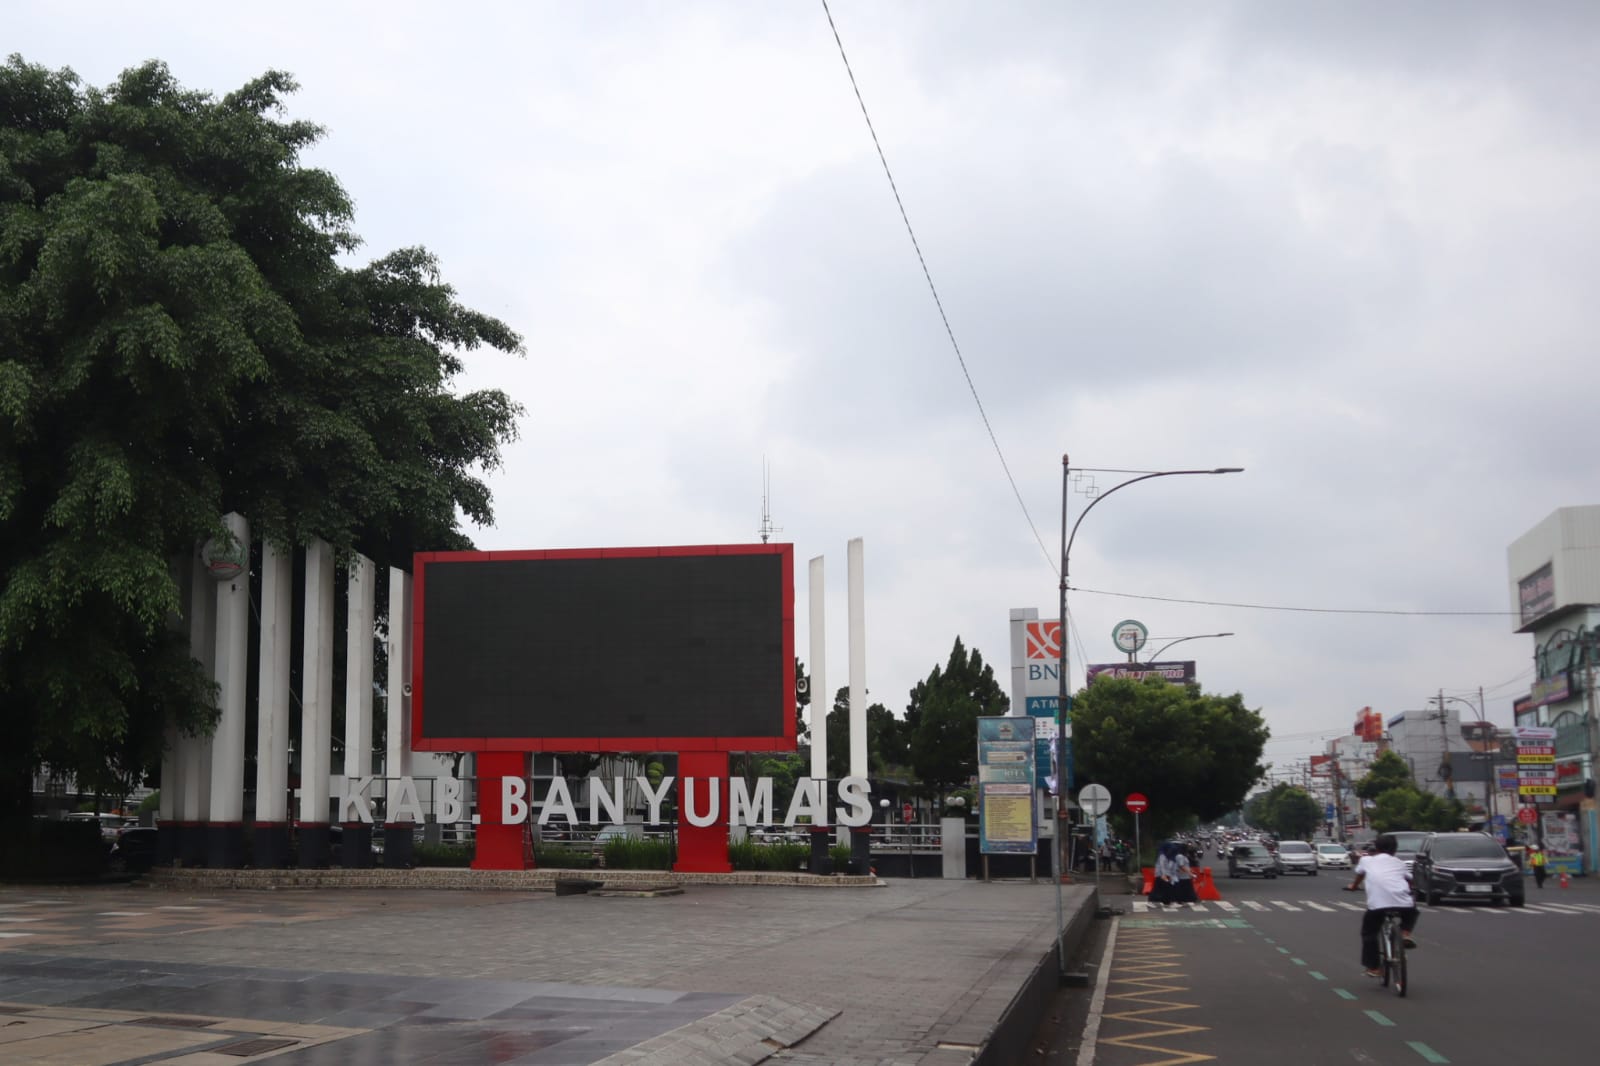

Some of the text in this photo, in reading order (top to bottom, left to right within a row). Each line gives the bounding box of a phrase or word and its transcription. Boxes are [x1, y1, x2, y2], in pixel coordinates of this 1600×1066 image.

[1029, 664, 1061, 680] BN
[1031, 699, 1059, 709] ATM
[338, 775, 874, 828] KAB. BANYUMAS
